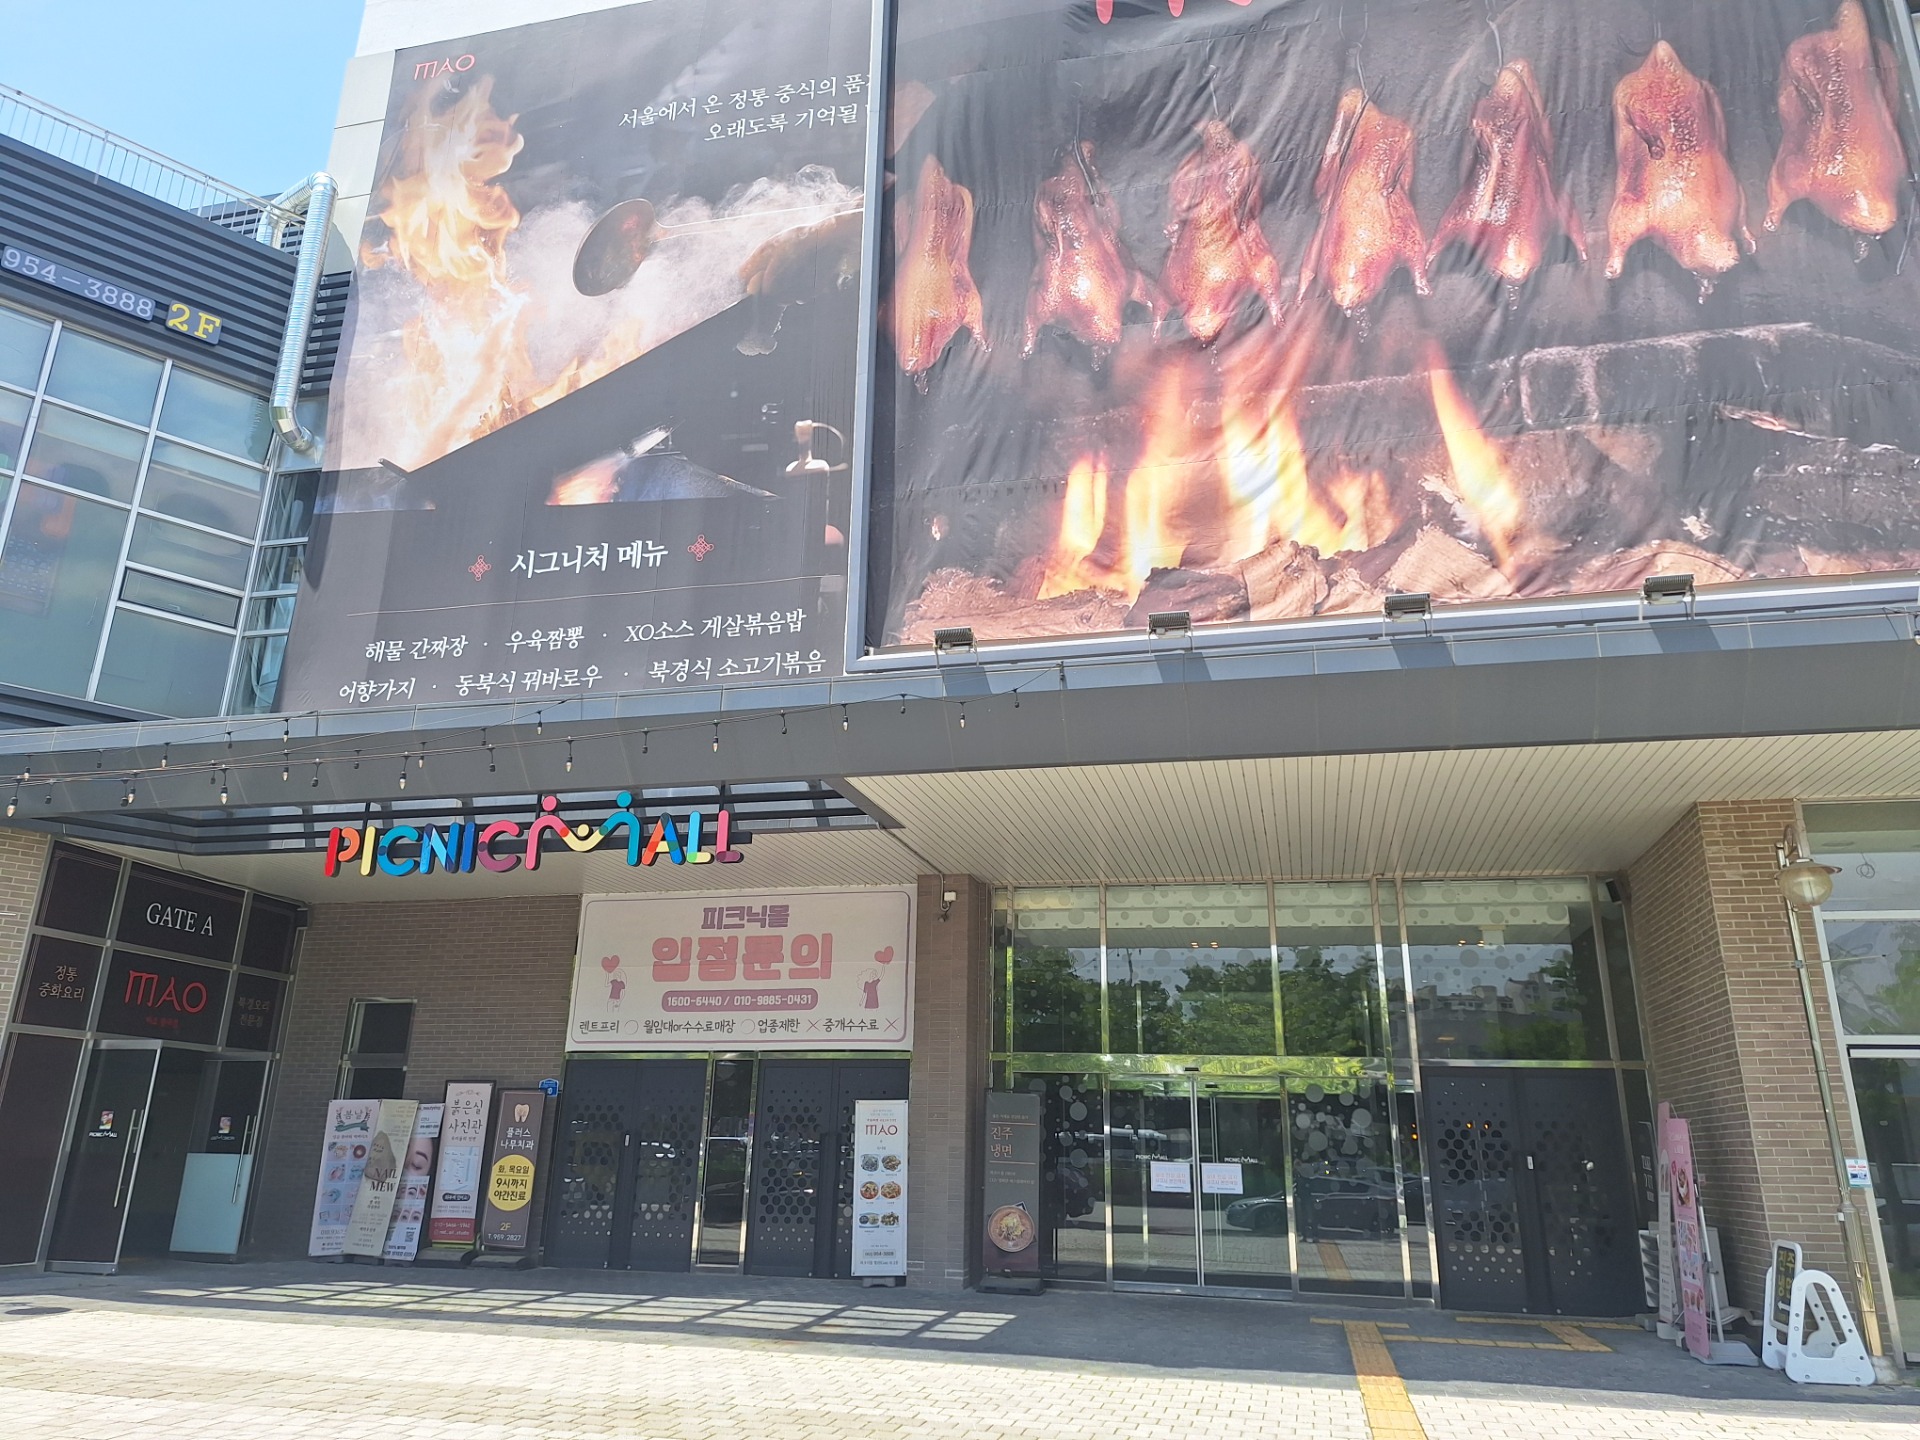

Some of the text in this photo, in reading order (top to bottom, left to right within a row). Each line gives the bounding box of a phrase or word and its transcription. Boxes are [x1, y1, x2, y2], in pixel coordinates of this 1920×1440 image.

[414, 54, 476, 80] MAO
[618, 97, 697, 129] 서울에서
[701, 94, 723, 114] 온
[728, 87, 769, 110] 정통
[774, 76, 837, 103] 중식의
[704, 113, 788, 142] 오래도록
[794, 103, 858, 129] 기억될
[4, 250, 153, 319] 954-3888
[168, 303, 220, 339] 2F
[510, 539, 669, 579] 시그니처 메뉴
[365, 608, 807, 663] 해물 간짜장 우육짬뽕 XO소스 게살볶음밥
[339, 649, 827, 703] 어향가지 동북식 꿔바로우 북경식 소고기볶음
[146, 902, 214, 937] GATE A
[701, 904, 790, 930] 피크닉몰
[652, 933, 833, 982] 입점문의
[55, 965, 78, 982] 정통
[38, 981, 85, 1002] 중화요리
[124, 970, 208, 1014] MAO
[667, 996, 722, 1007] 1600-6440
[733, 994, 812, 1006] 010-9885-0431
[579, 1017, 880, 1035] 렌트프리 월임대or수수료매장 업종제한 중개수수료
[344, 1109, 364, 1120] 봄날
[451, 1099, 484, 1116] 붉은실
[448, 1118, 484, 1135] 사진관
[506, 1127, 532, 1138] 플러스
[865, 1124, 898, 1136] MAO
[991, 1126, 1014, 1140] 진주
[500, 1140, 535, 1151] 나무치과
[990, 1143, 1012, 1158] 냉면
[374, 1167, 398, 1179] NAIL
[509, 1165, 530, 1175] 목요일
[370, 1181, 397, 1192] MEW
[496, 1178, 528, 1190] 9시까지
[493, 1190, 527, 1202] 야간진료
[500, 1222, 512, 1231] 2F
